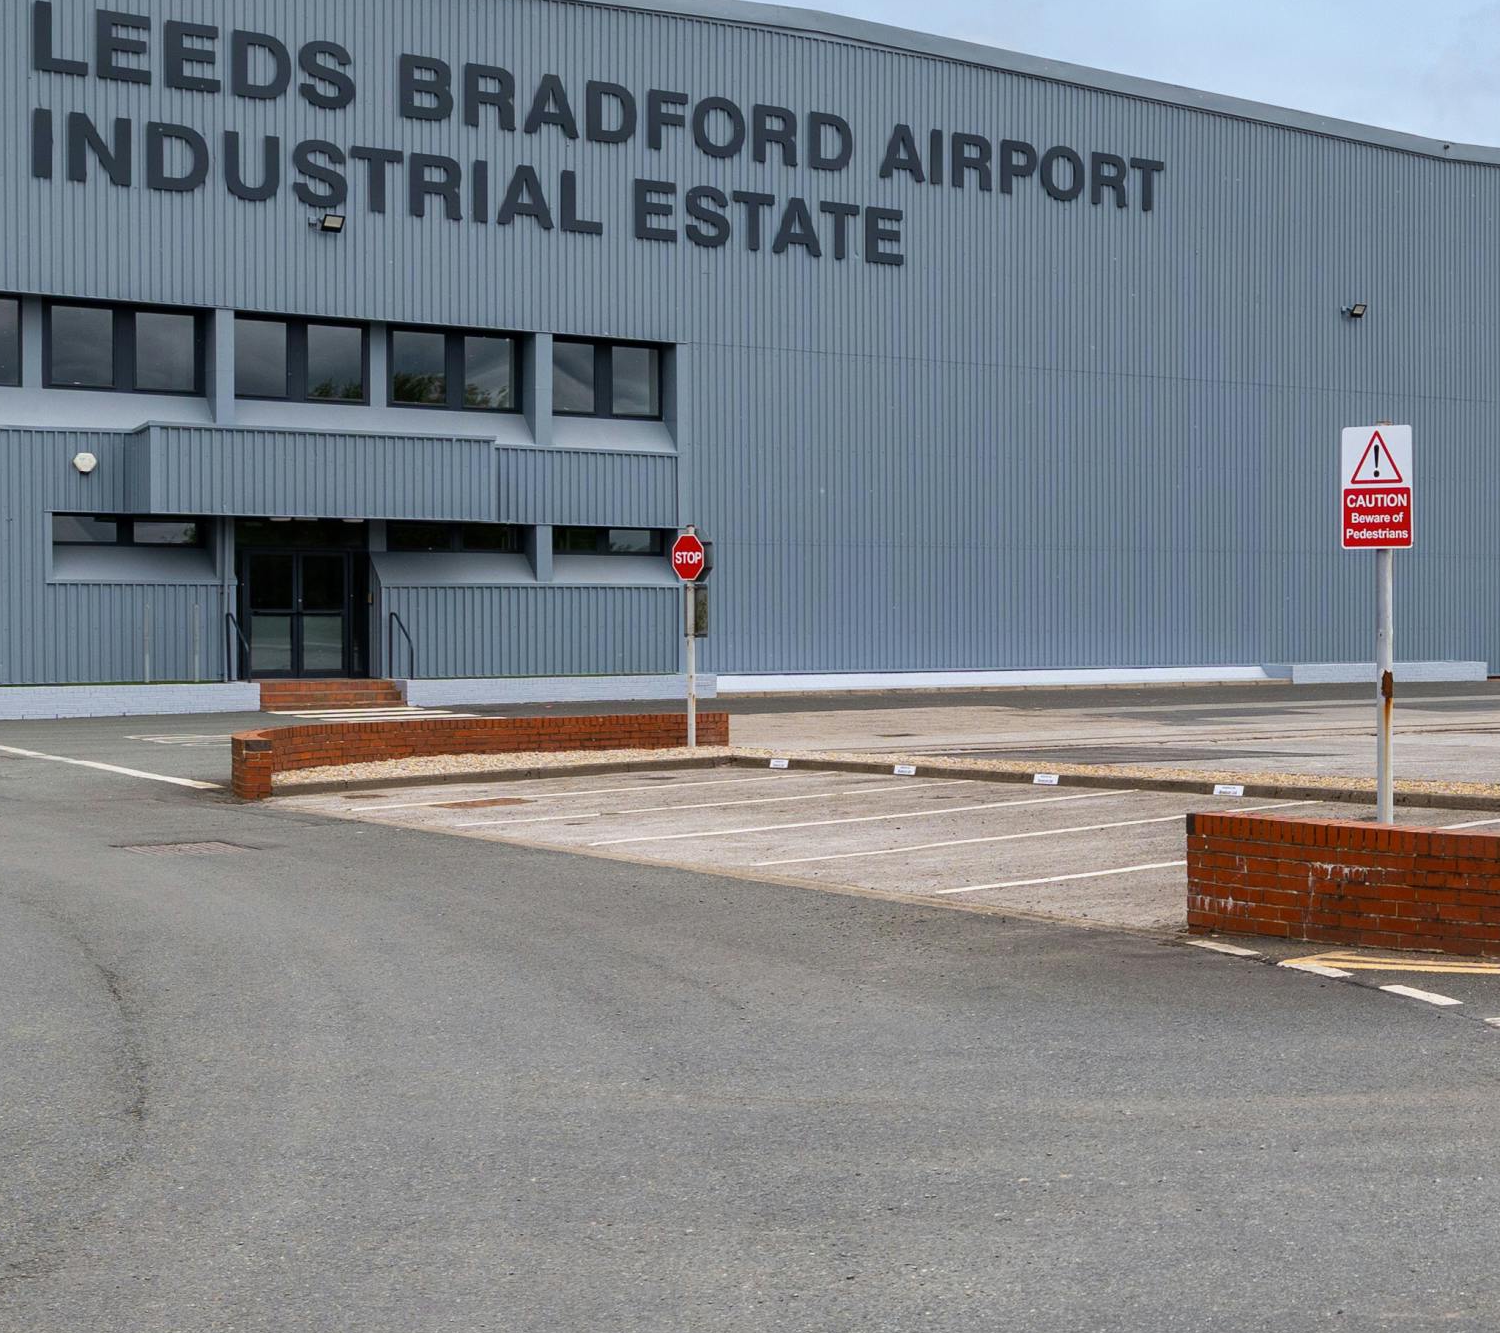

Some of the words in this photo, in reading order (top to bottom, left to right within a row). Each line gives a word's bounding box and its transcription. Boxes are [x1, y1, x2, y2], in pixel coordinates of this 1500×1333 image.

[33, 0, 356, 109] LEEDS
[399, 53, 852, 171] BRADFORD
[879, 123, 1165, 212] AIRPORT
[32, 107, 603, 235] INDUSTRIAL
[634, 178, 904, 266] ESTATE
[1346, 493, 1408, 508] CAUTION
[1351, 512, 1391, 524] Beware
[1392, 512, 1404, 523] of
[1346, 528, 1409, 539] Pedestrians
[675, 551, 702, 564] STOP
